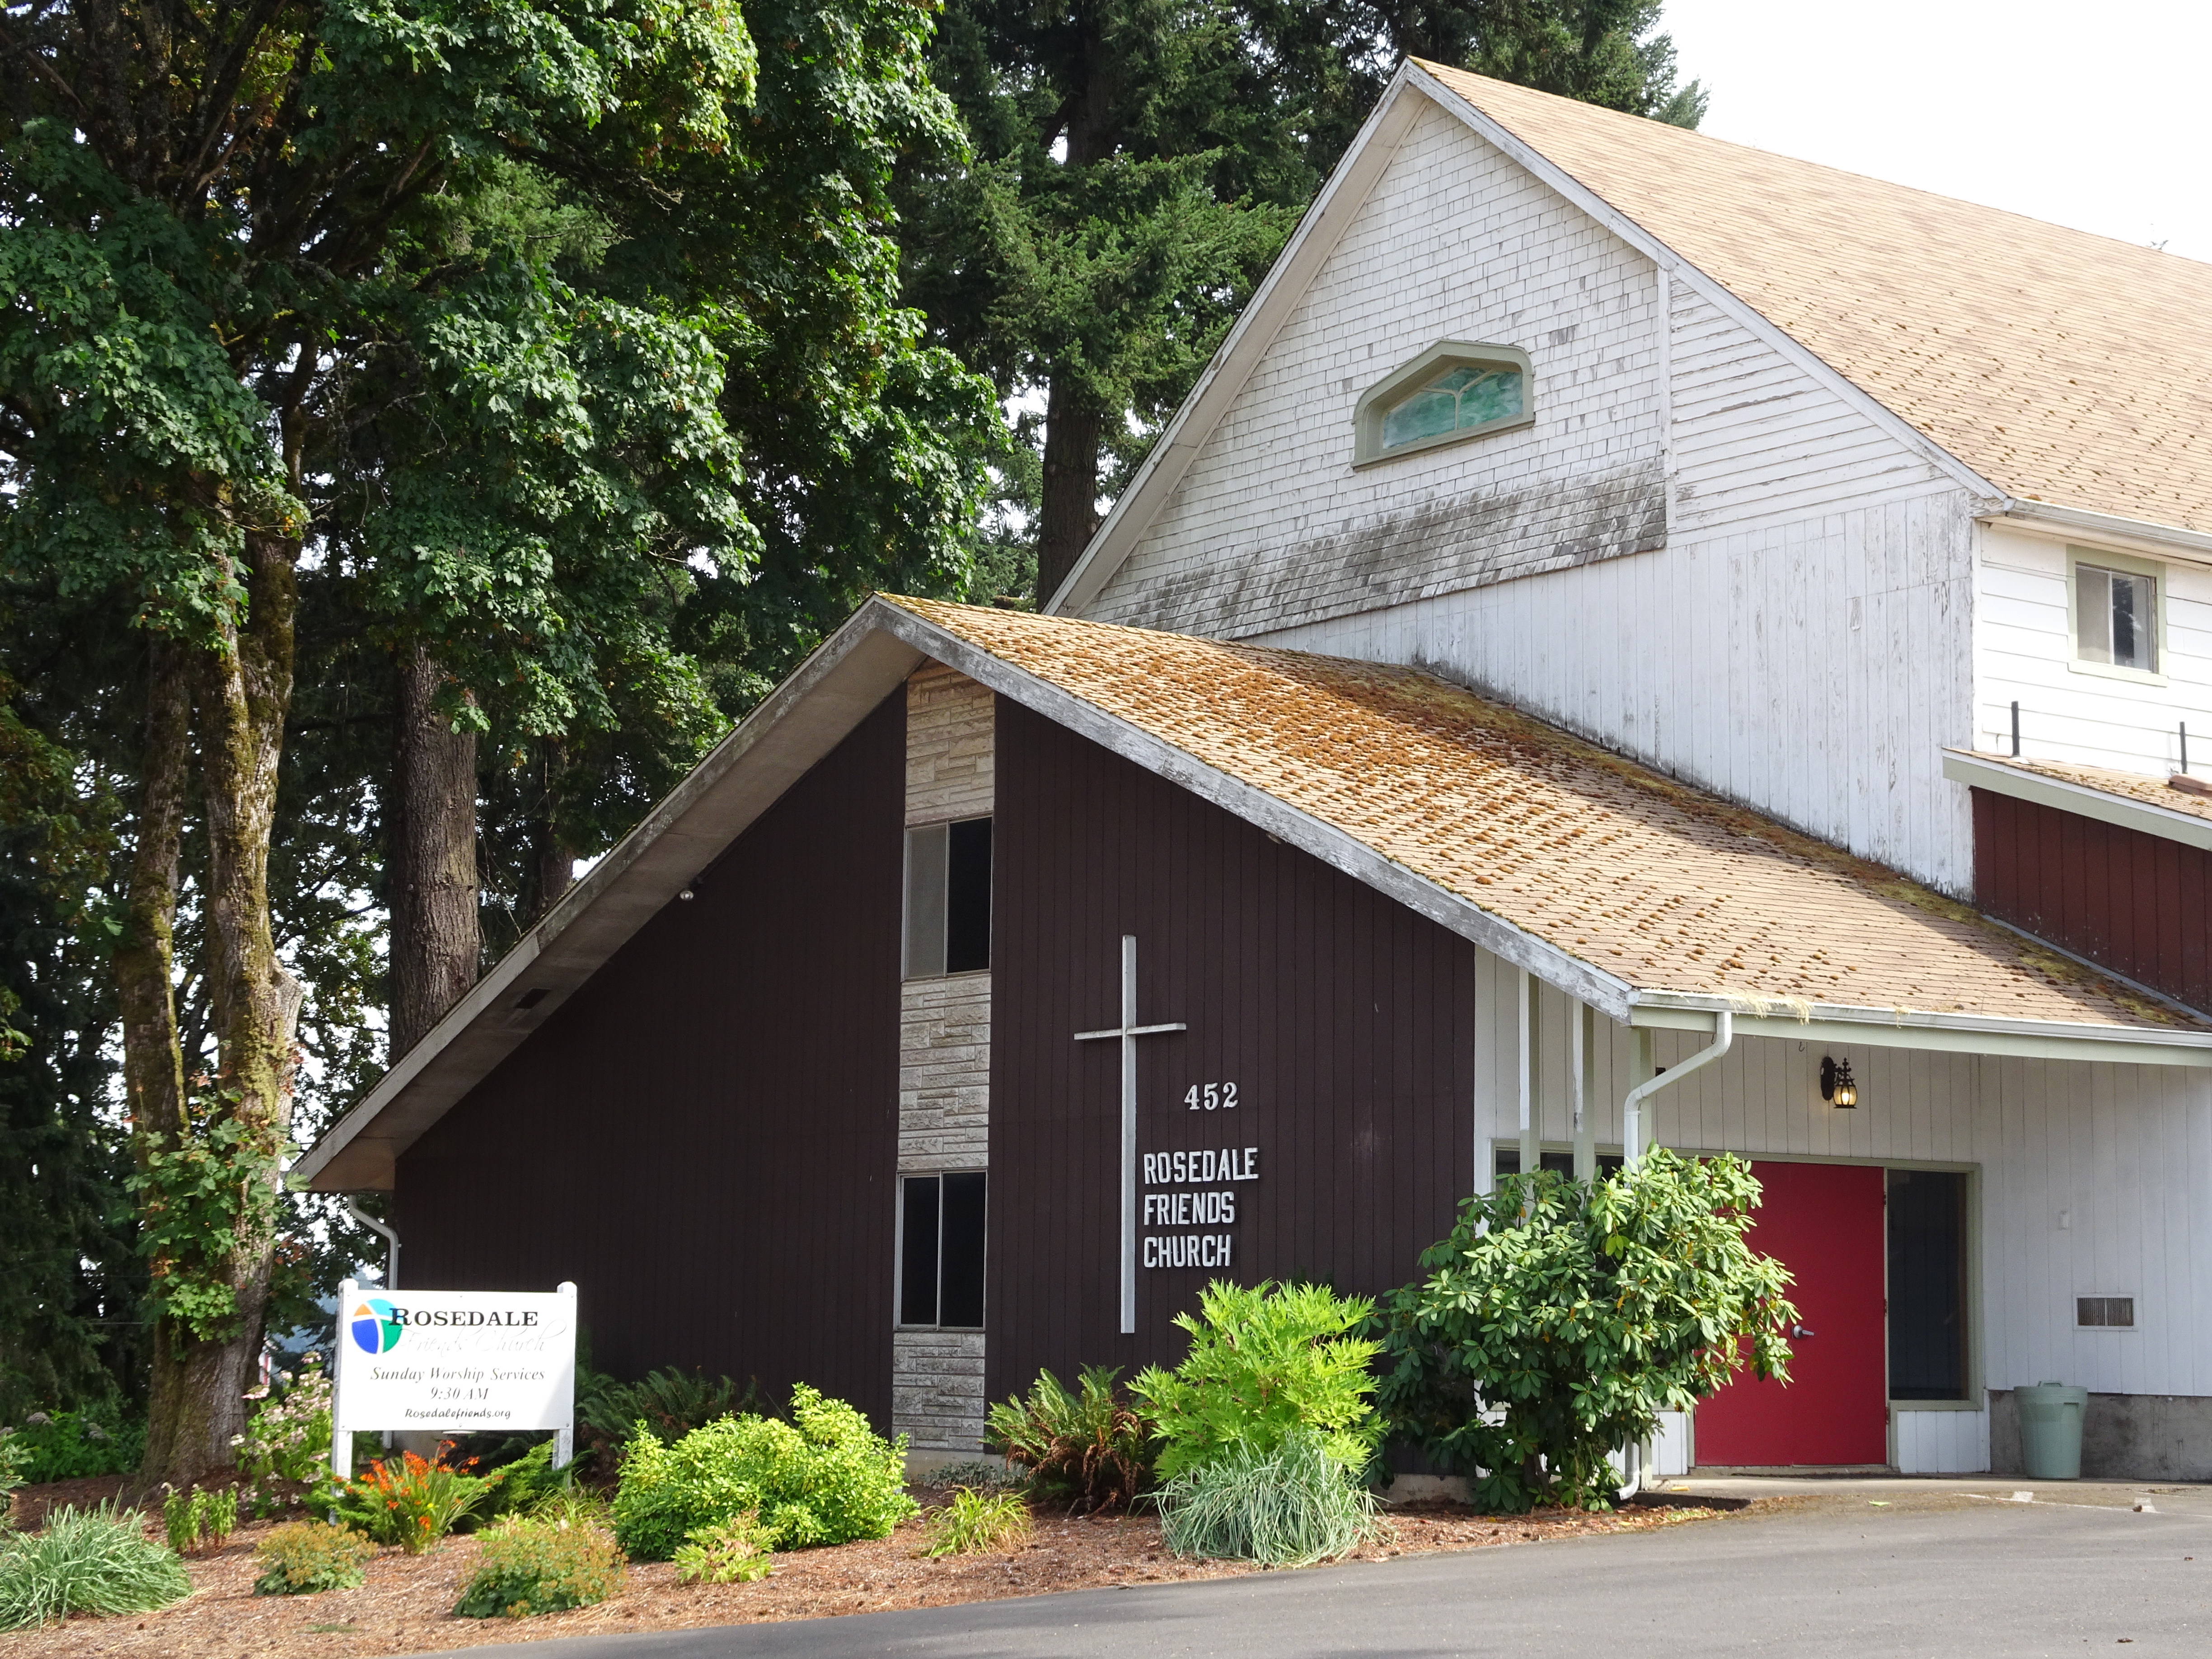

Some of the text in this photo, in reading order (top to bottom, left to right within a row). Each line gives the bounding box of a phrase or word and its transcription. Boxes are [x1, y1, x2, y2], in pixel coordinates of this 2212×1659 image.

[1184, 1082, 1238, 1111] 452
[1143, 1147, 1259, 1185] ROSEDALE
[1143, 1191, 1235, 1226] FRIENDS
[1143, 1234, 1232, 1268] CHURCH
[388, 1308, 538, 1326] ROSEDALE
[397, 1319, 567, 1357] Friends Church
[370, 1367, 545, 1383] Sunday Worship Services
[430, 1386, 489, 1400] 9:30 AM
[404, 1407, 511, 1420] Rosedalefriends.org
